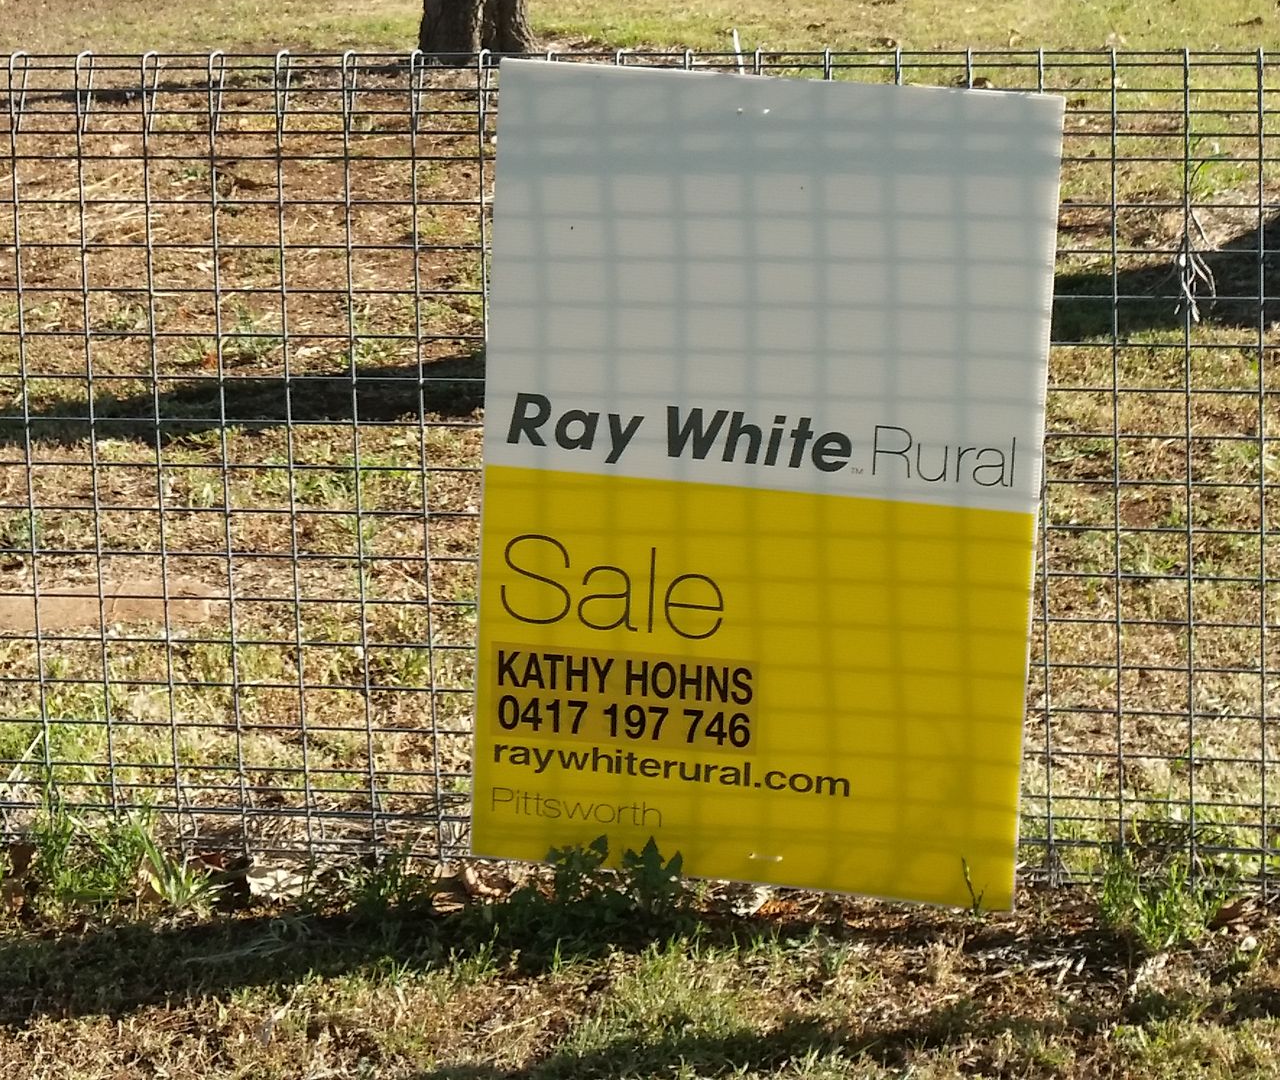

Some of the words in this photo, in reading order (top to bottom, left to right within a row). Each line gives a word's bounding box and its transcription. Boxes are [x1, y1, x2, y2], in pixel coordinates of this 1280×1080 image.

[506, 392, 645, 463] Ray
[666, 405, 852, 472] White
[872, 425, 1017, 488] Rural
[500, 534, 724, 640] Sale
[497, 650, 615, 694] KATHY
[625, 660, 753, 705] HOHNS
[498, 695, 588, 734] 0417
[603, 704, 667, 741] 197
[683, 709, 751, 748] 746
[493, 743, 851, 797] raywhiterural.com
[491, 786, 662, 827] Pittsworth
